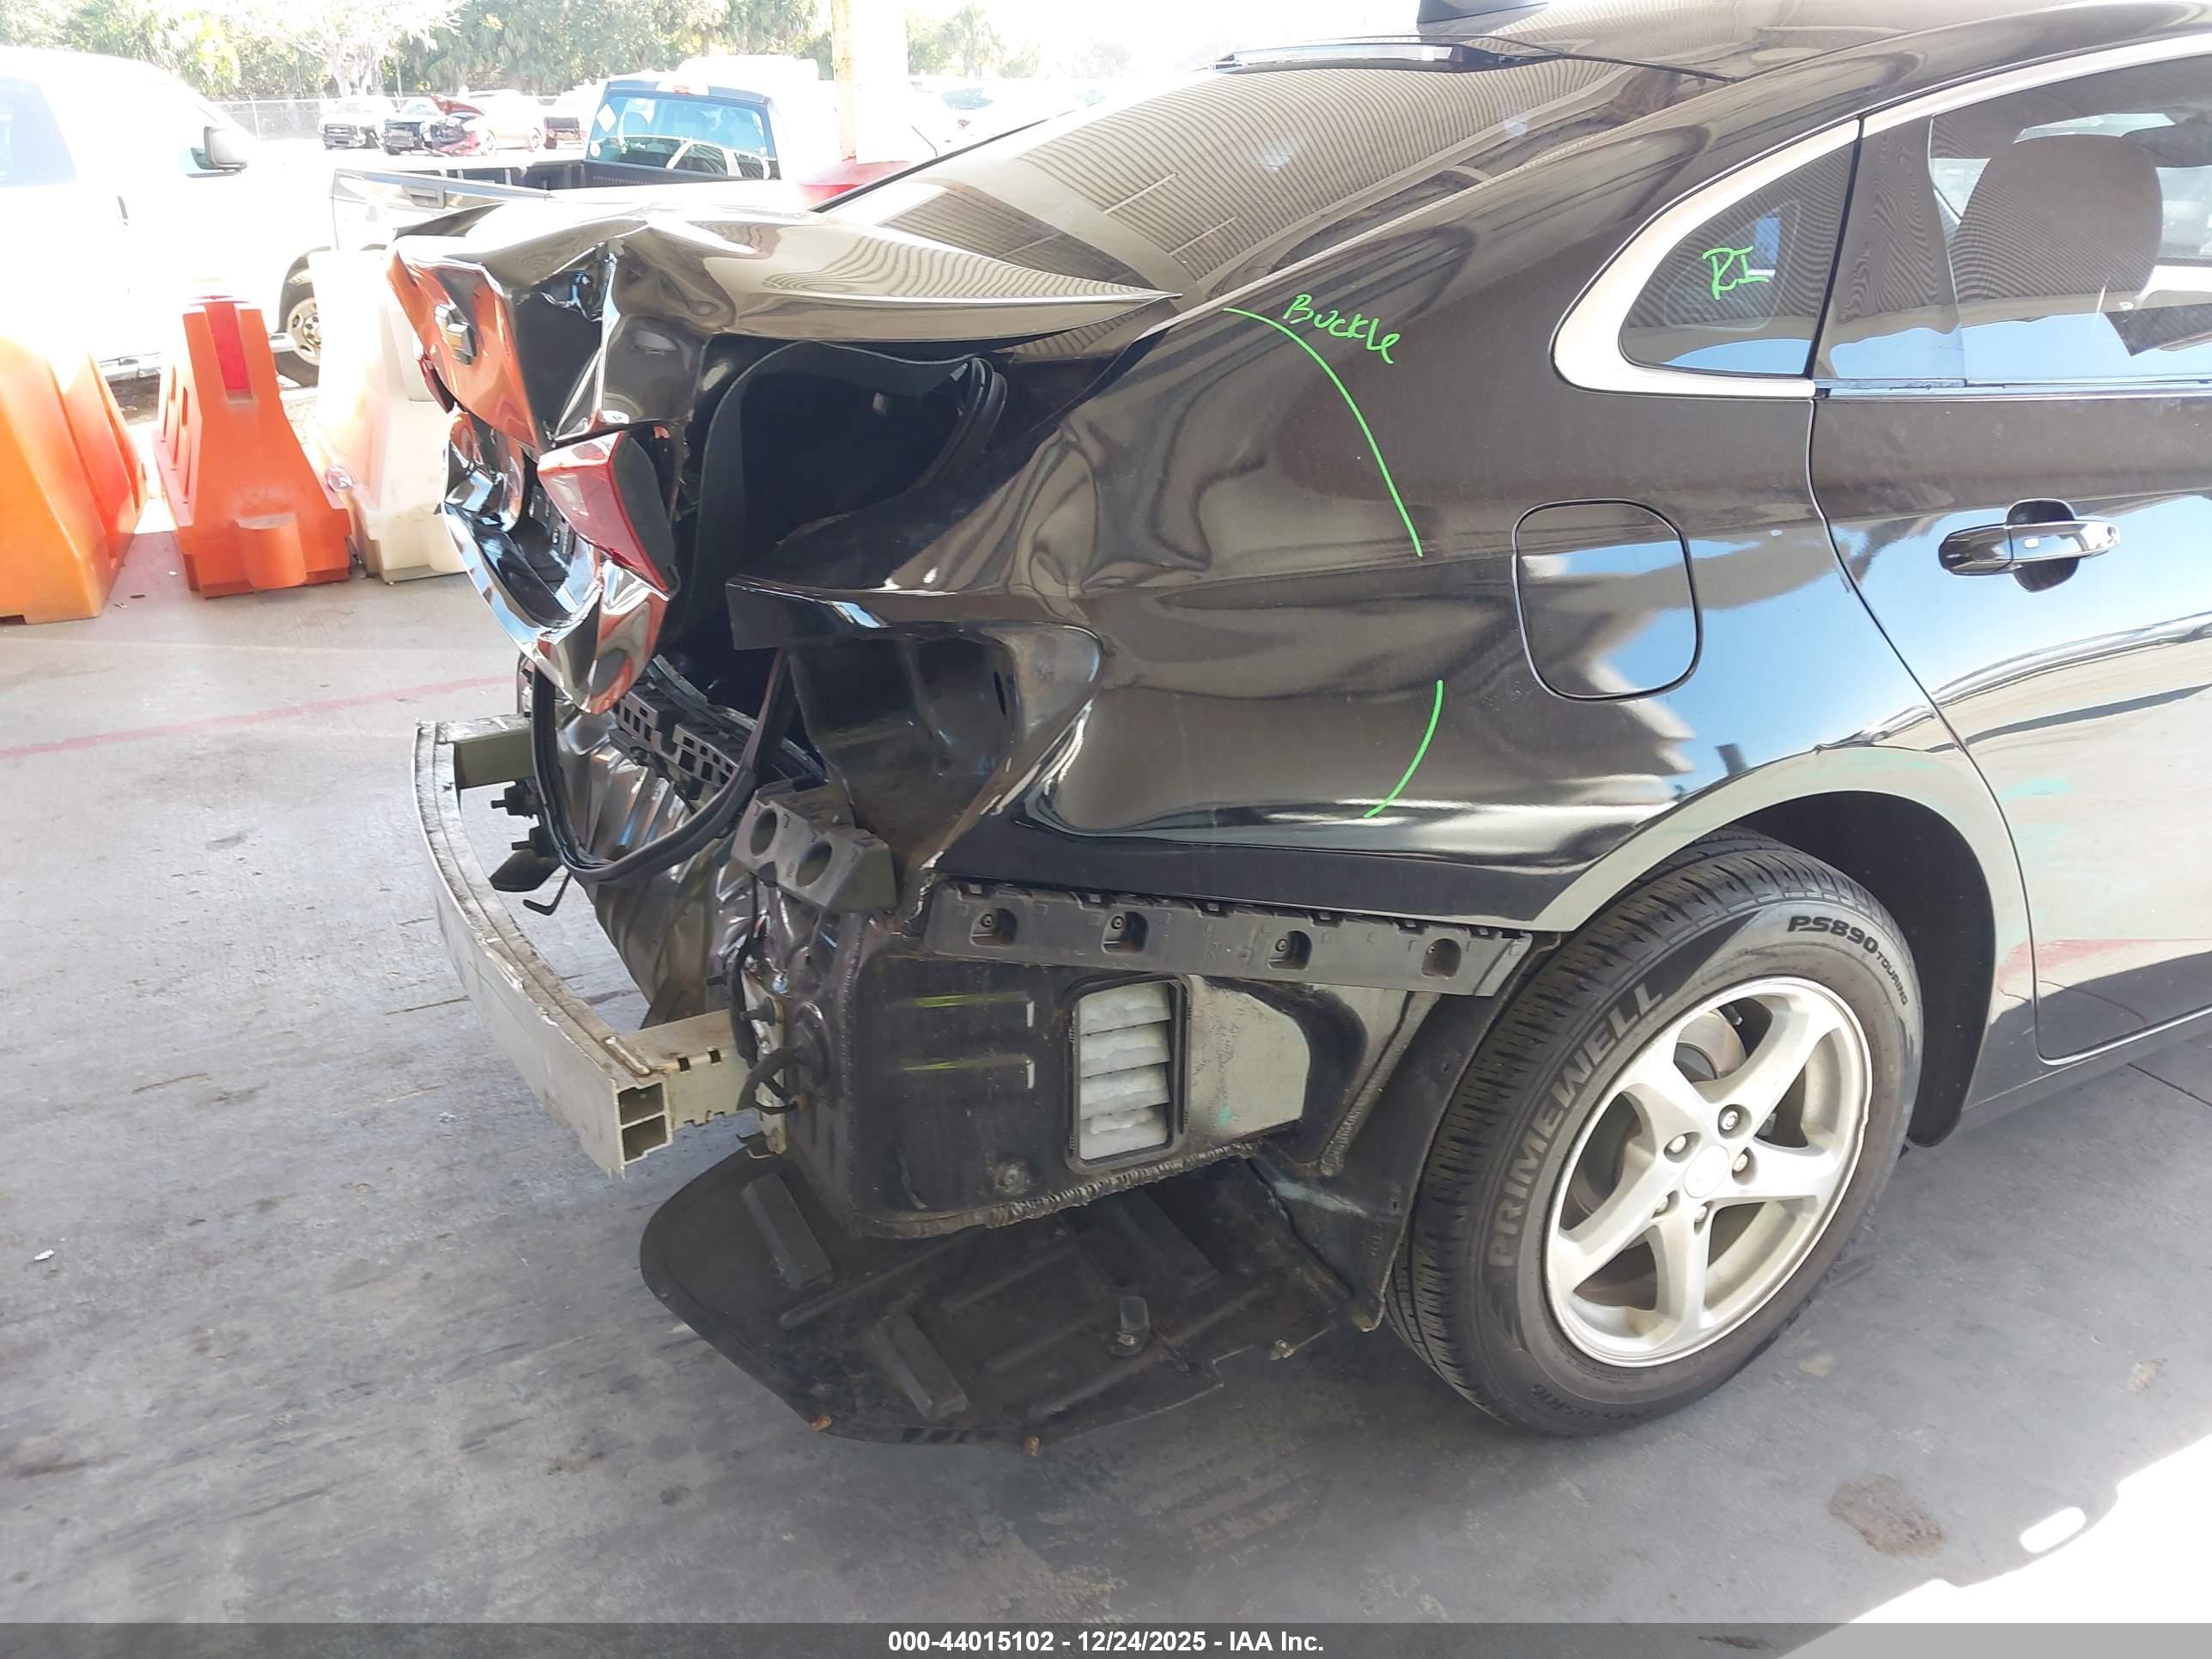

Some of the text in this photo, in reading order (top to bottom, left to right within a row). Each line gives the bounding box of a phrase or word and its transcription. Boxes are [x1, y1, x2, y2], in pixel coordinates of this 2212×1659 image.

[1787, 915, 1909, 1006] PS890 TOURING
[1486, 982, 1664, 1267] PRIMEWELL
